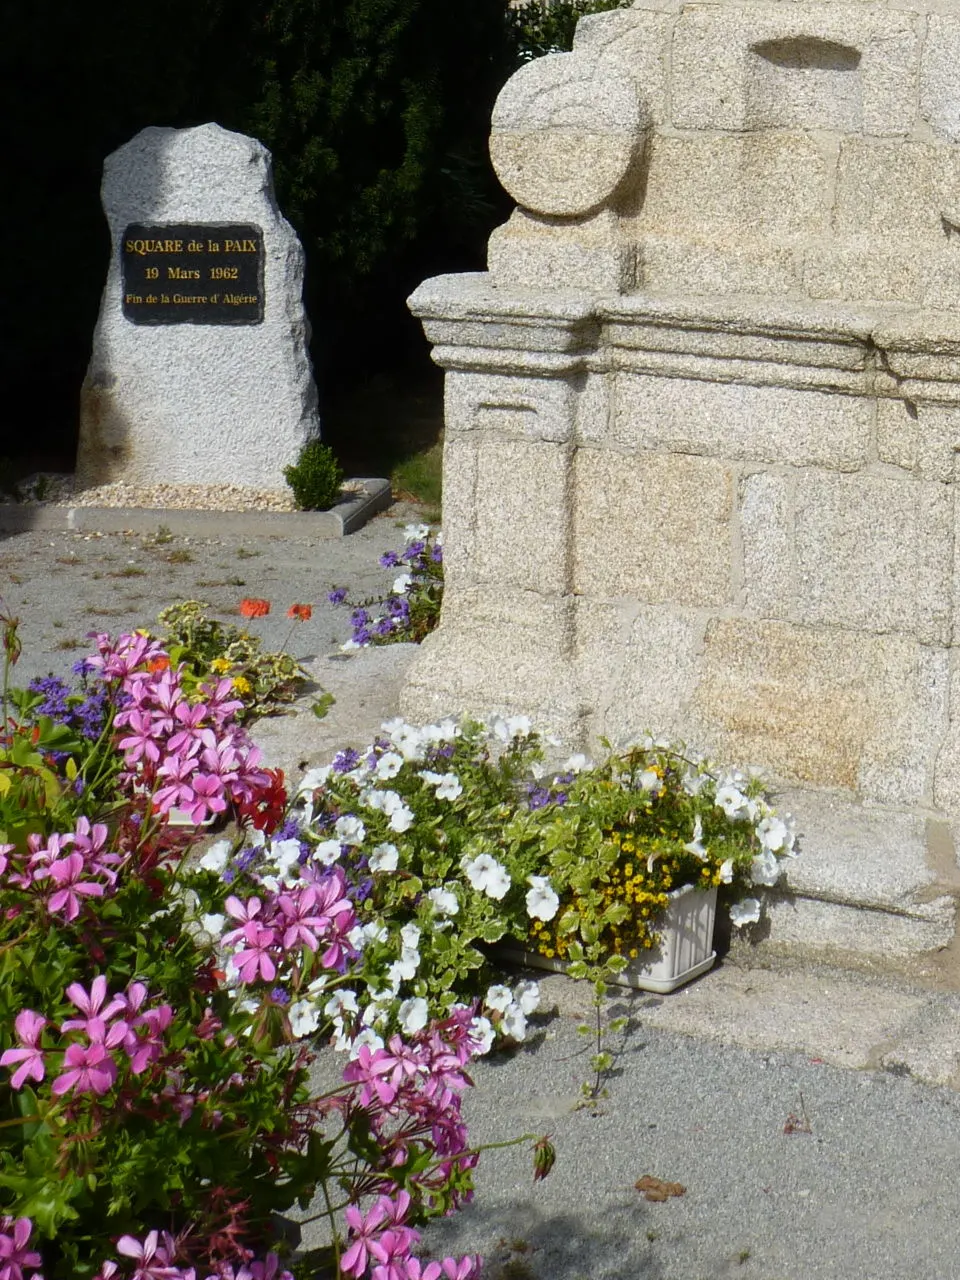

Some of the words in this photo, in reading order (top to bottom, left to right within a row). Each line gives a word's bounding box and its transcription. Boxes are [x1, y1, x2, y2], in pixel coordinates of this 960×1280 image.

[126, 240, 183, 255] SQUARE
[188, 240, 203, 252] de
[208, 240, 219, 252] la
[225, 240, 257, 252] PAIX
[145, 267, 159, 279] 19
[168, 267, 200, 279] Mars
[210, 267, 238, 279] 1962
[126, 294, 143, 304] Fin
[146, 294, 157, 304] de
[161, 294, 170, 304] la
[173, 294, 207, 304] Guerre
